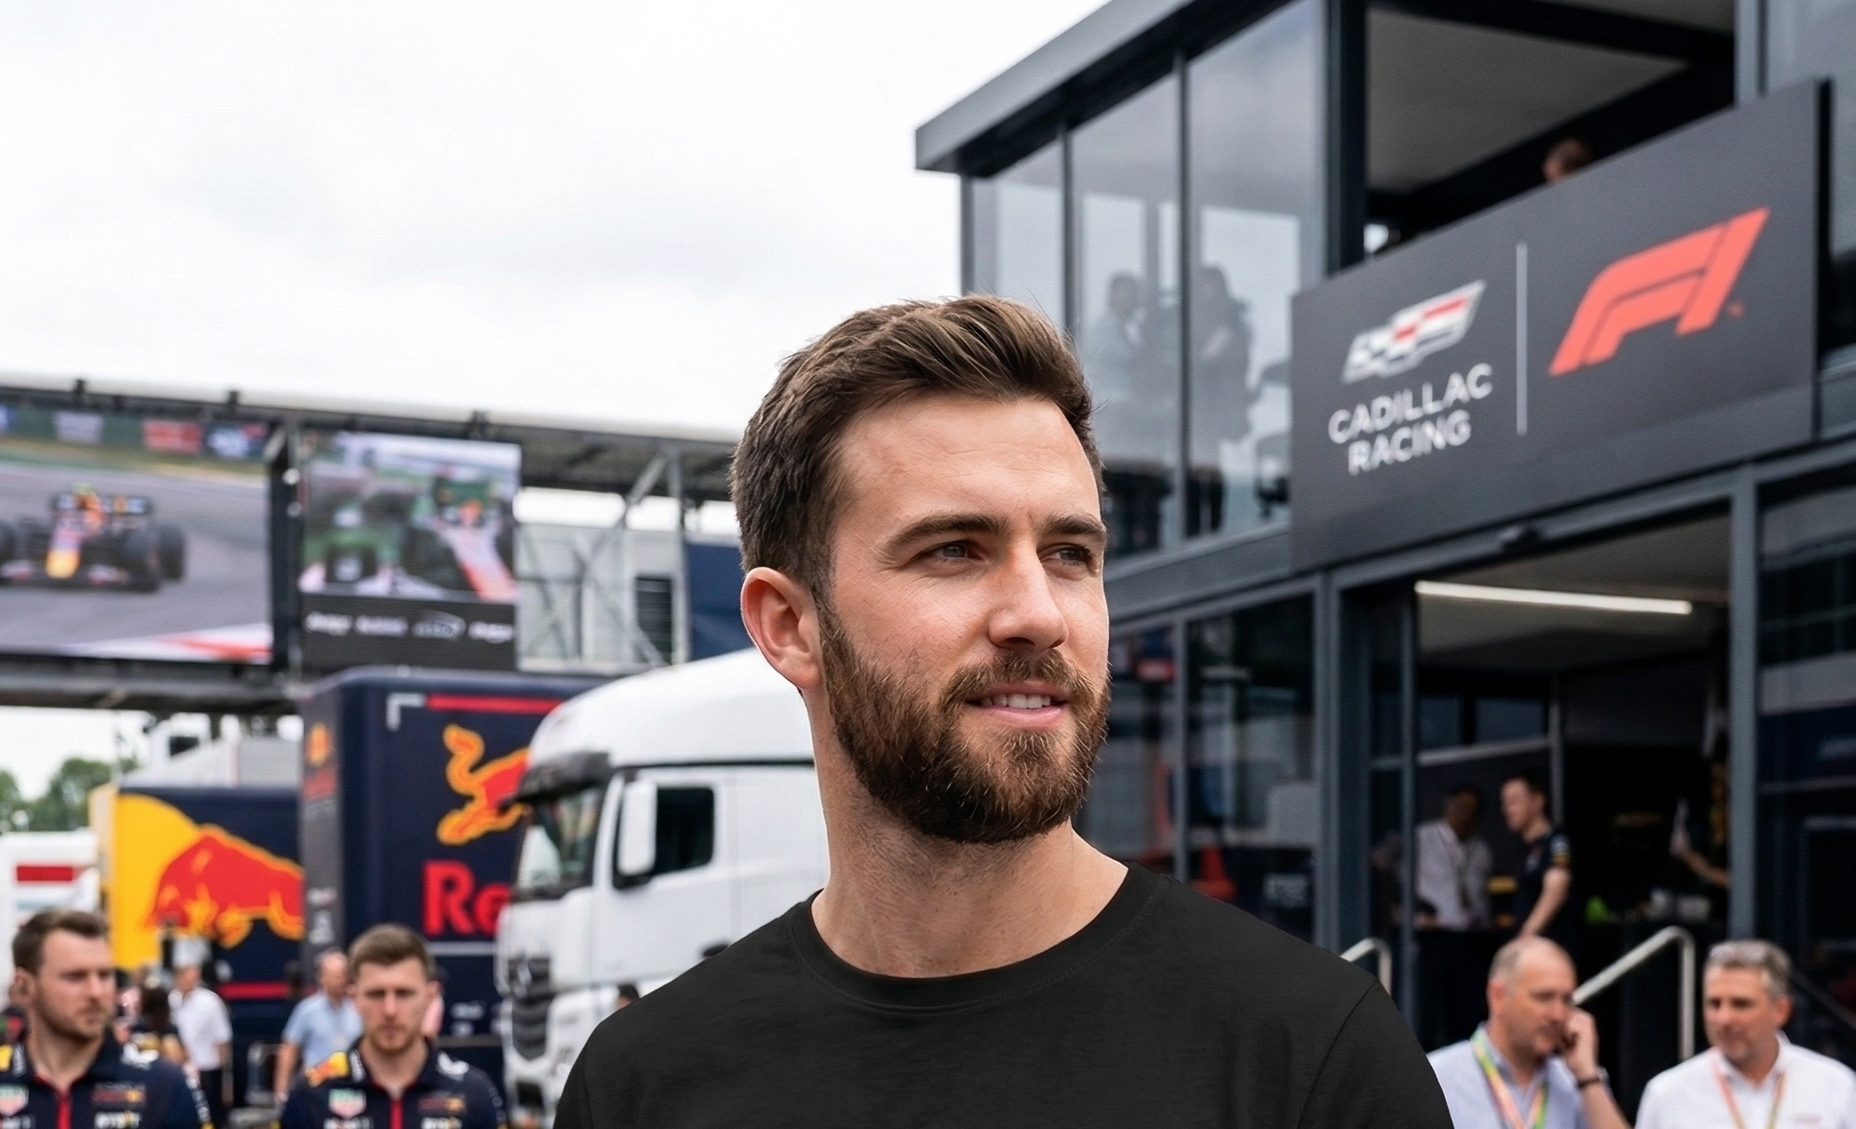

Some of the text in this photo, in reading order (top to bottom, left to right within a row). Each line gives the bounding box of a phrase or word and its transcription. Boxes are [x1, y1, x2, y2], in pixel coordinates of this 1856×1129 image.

[1549, 206, 1770, 376] F1
[1328, 363, 1493, 444] CADILLAC
[1348, 409, 1472, 476] RACING
